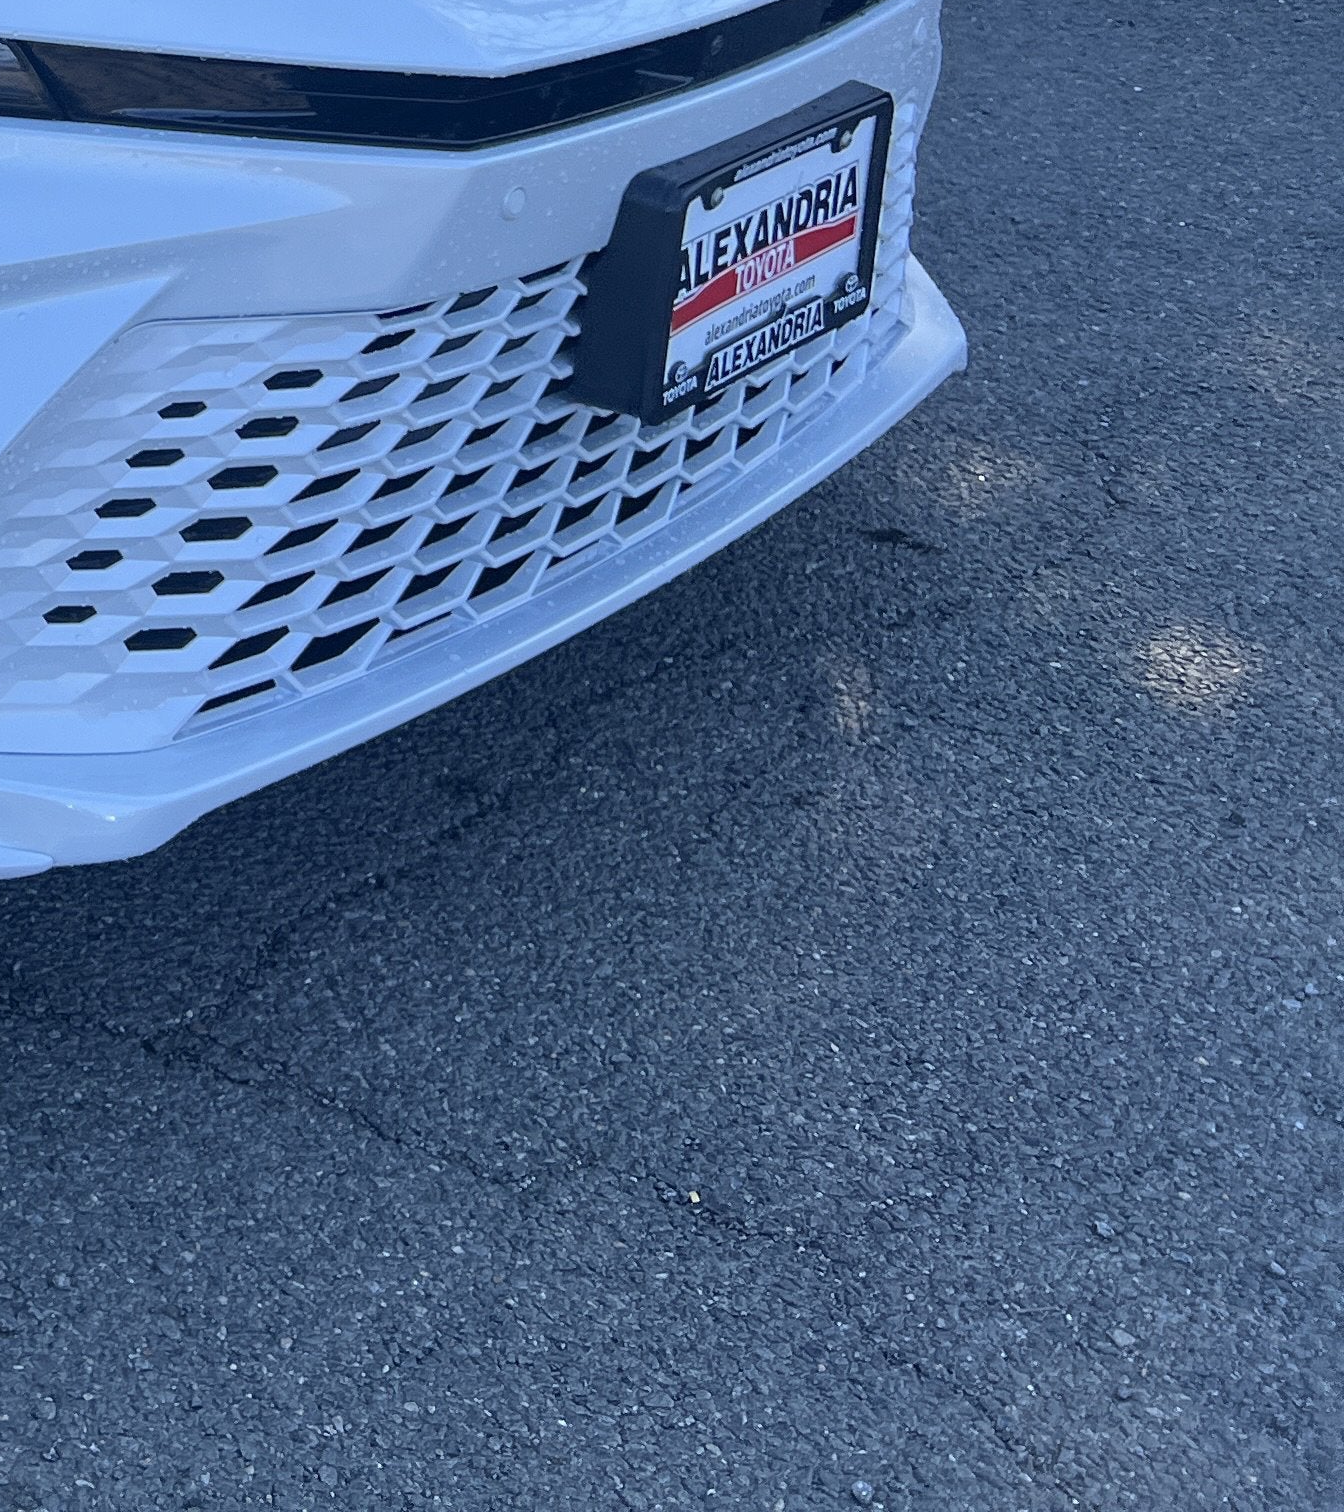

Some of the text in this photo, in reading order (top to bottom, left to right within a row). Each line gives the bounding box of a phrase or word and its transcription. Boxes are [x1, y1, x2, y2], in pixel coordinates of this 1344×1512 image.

[676, 165, 858, 297] ALEXANDRIA
[735, 239, 795, 295] TOYOTA
[705, 274, 816, 346] alexandriatoyota.com
[834, 287, 866, 314] TOYOTA
[706, 299, 824, 389] ALEXANDRIA
[663, 375, 698, 406] TOYOTA
